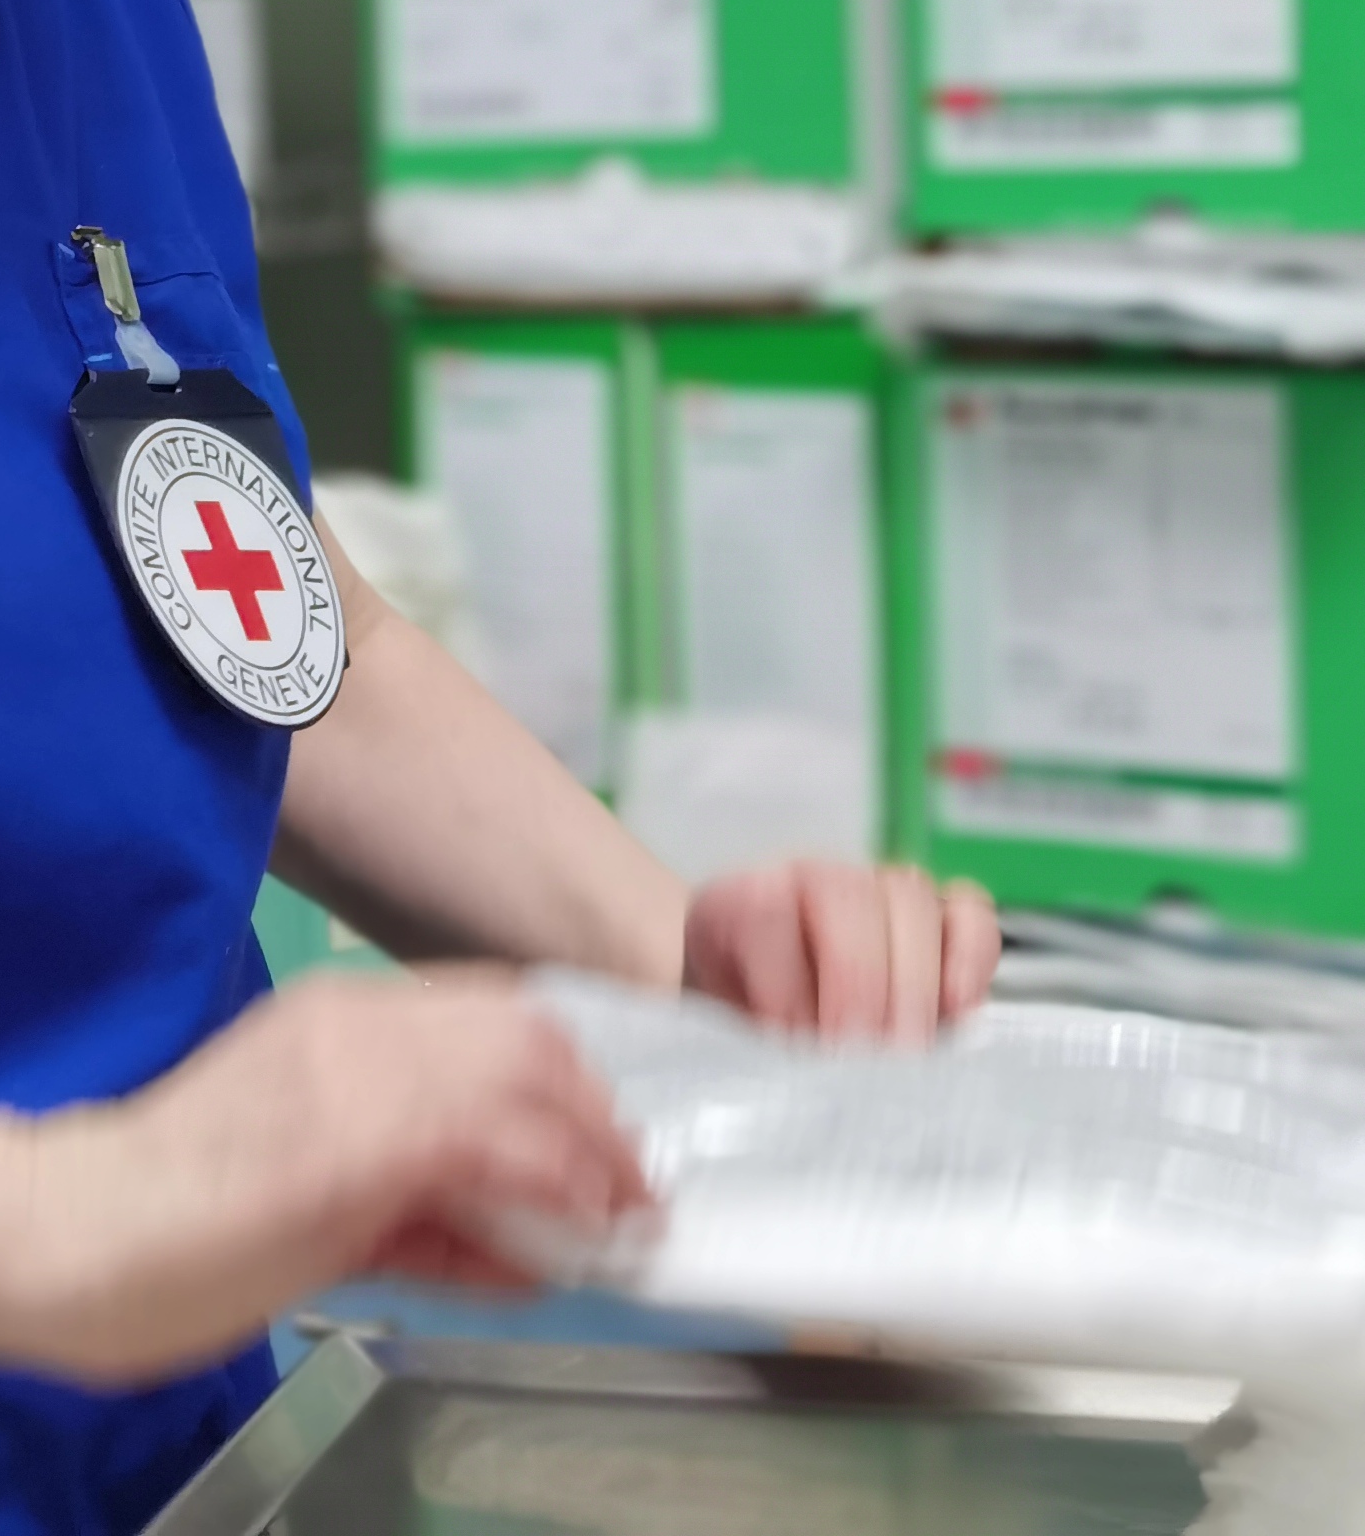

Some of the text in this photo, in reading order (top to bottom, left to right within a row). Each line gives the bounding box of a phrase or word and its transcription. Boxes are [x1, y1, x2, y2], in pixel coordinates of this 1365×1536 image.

[132, 436, 332, 632] COMITE INTERNATIONAL
[216, 652, 325, 707] GENEVE
